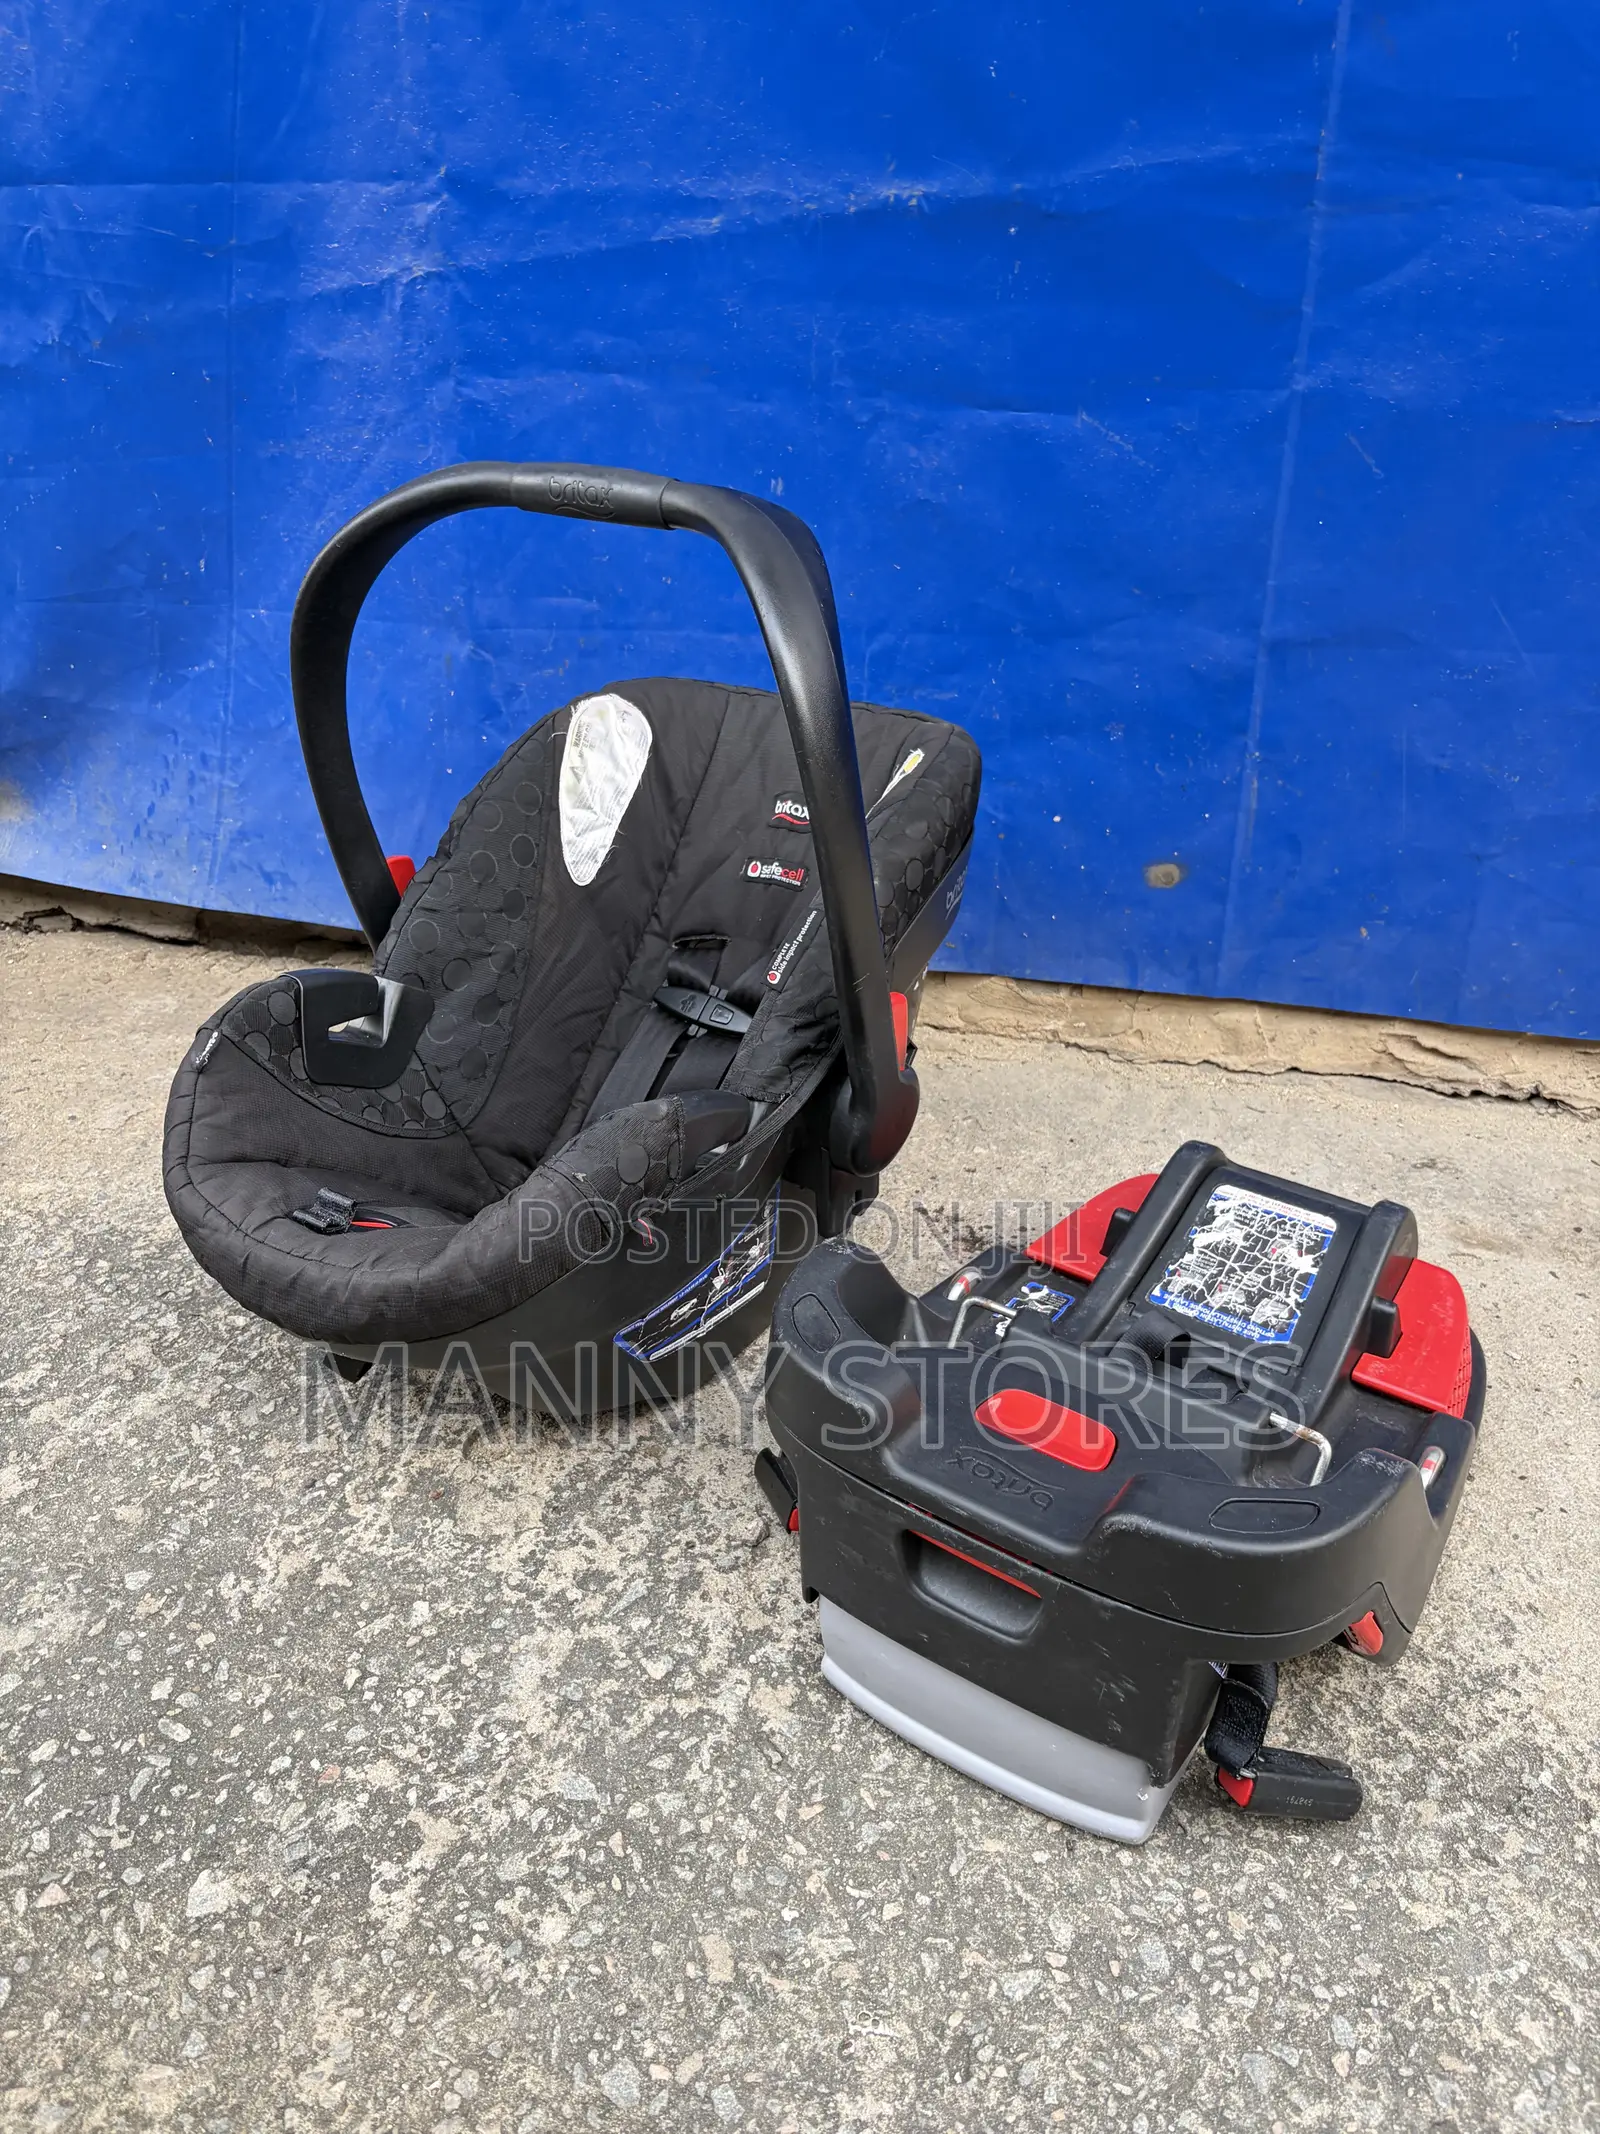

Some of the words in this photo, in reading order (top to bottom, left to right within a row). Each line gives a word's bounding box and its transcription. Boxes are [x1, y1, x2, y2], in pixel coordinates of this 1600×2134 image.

[549, 475, 614, 509] britax
[760, 862, 804, 881] safecell
[772, 943, 790, 970] COMPLETE
[778, 961, 788, 973] side
[784, 941, 799, 961] impact
[796, 910, 817, 942] protection
[944, 1451, 1054, 1511] britax
